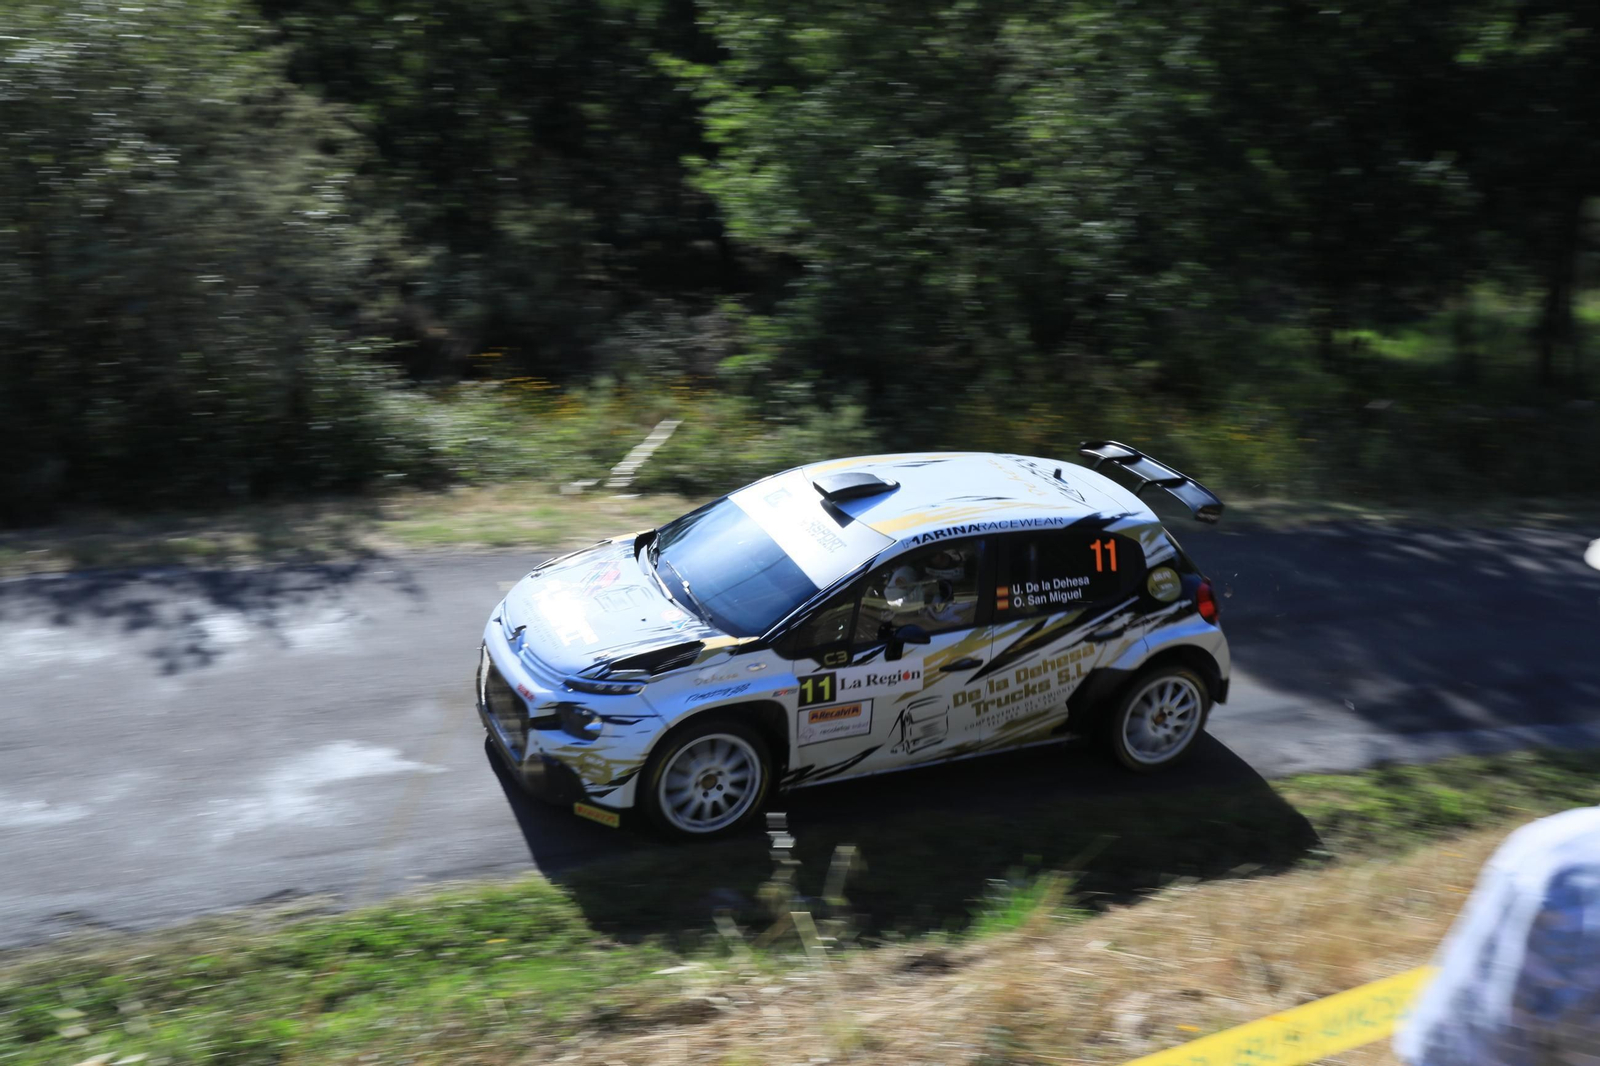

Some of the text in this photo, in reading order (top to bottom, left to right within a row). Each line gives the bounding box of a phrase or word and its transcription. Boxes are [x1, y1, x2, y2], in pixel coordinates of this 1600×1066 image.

[1090, 538, 1117, 572] 11
[1012, 576, 1090, 595] U. De la Dehesa
[1013, 588, 1082, 608] O. San Miguel
[824, 650, 848, 665] C3
[840, 678, 861, 691] La
[953, 643, 1095, 708] De la Dehesa
[801, 676, 831, 703] 11
[971, 679, 1051, 718] Trucks
